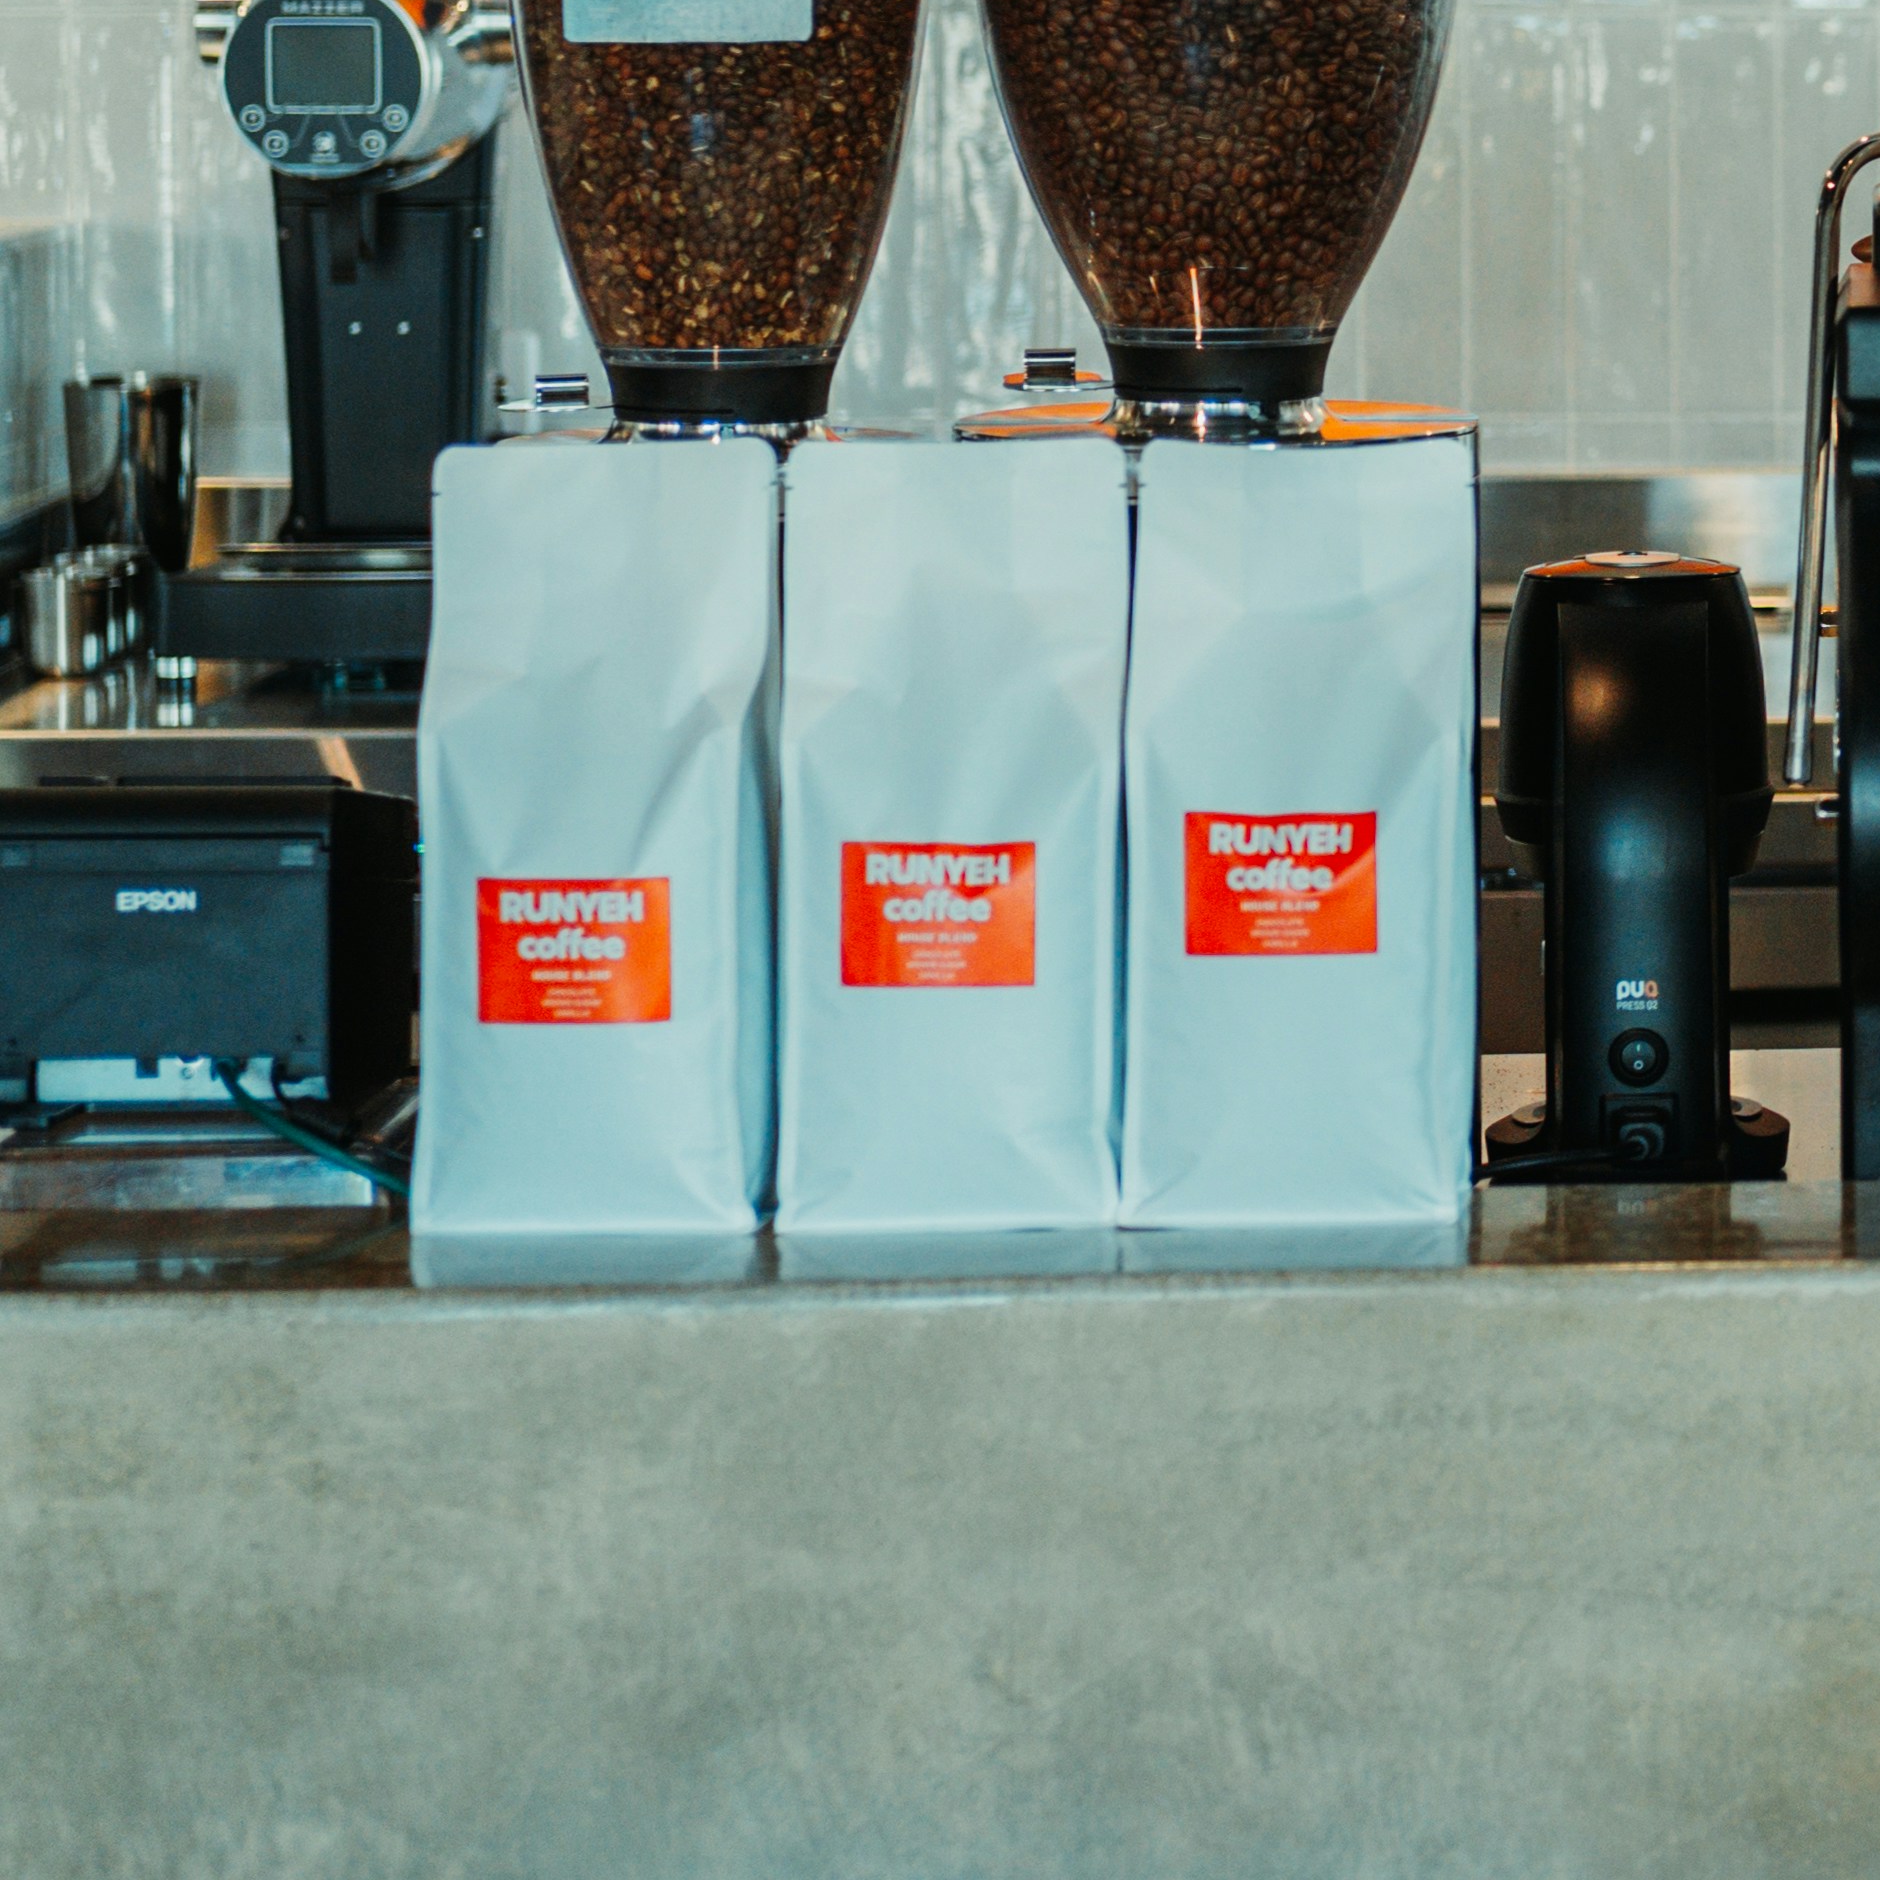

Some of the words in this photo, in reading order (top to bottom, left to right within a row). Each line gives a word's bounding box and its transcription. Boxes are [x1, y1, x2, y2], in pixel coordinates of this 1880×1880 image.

[1209, 822, 1353, 855] RUNYEH
[866, 853, 1010, 885] RUNYEH
[1227, 857, 1333, 891] coffee
[116, 891, 197, 911] EPSON
[501, 890, 644, 923] RUNYEH
[883, 889, 991, 922] coffee
[517, 927, 625, 960] coffee
[1616, 1001, 1645, 1010] PRESS
